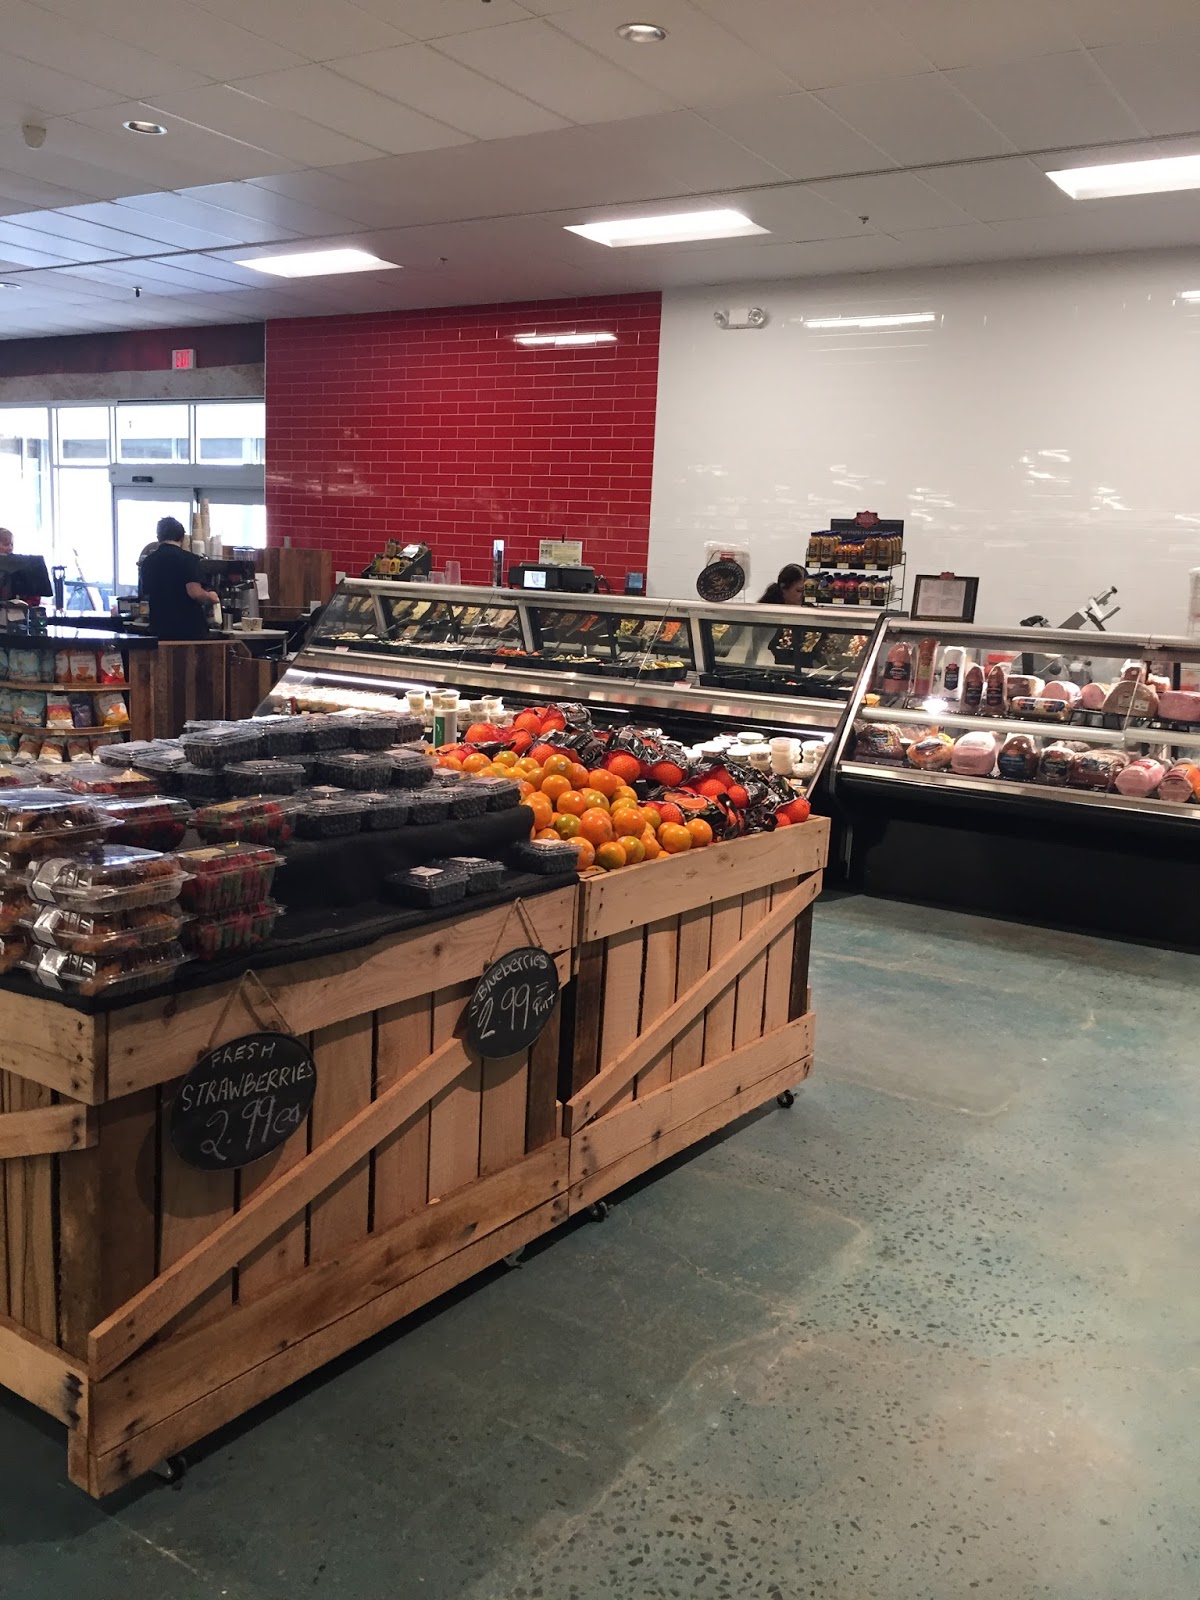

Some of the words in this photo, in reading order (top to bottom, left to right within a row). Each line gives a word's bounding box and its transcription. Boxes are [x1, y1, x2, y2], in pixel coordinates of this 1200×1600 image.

[175, 350, 191, 368] EXIT
[211, 1041, 276, 1068] FRESH
[181, 1060, 314, 1112] STRAWBERRIES
